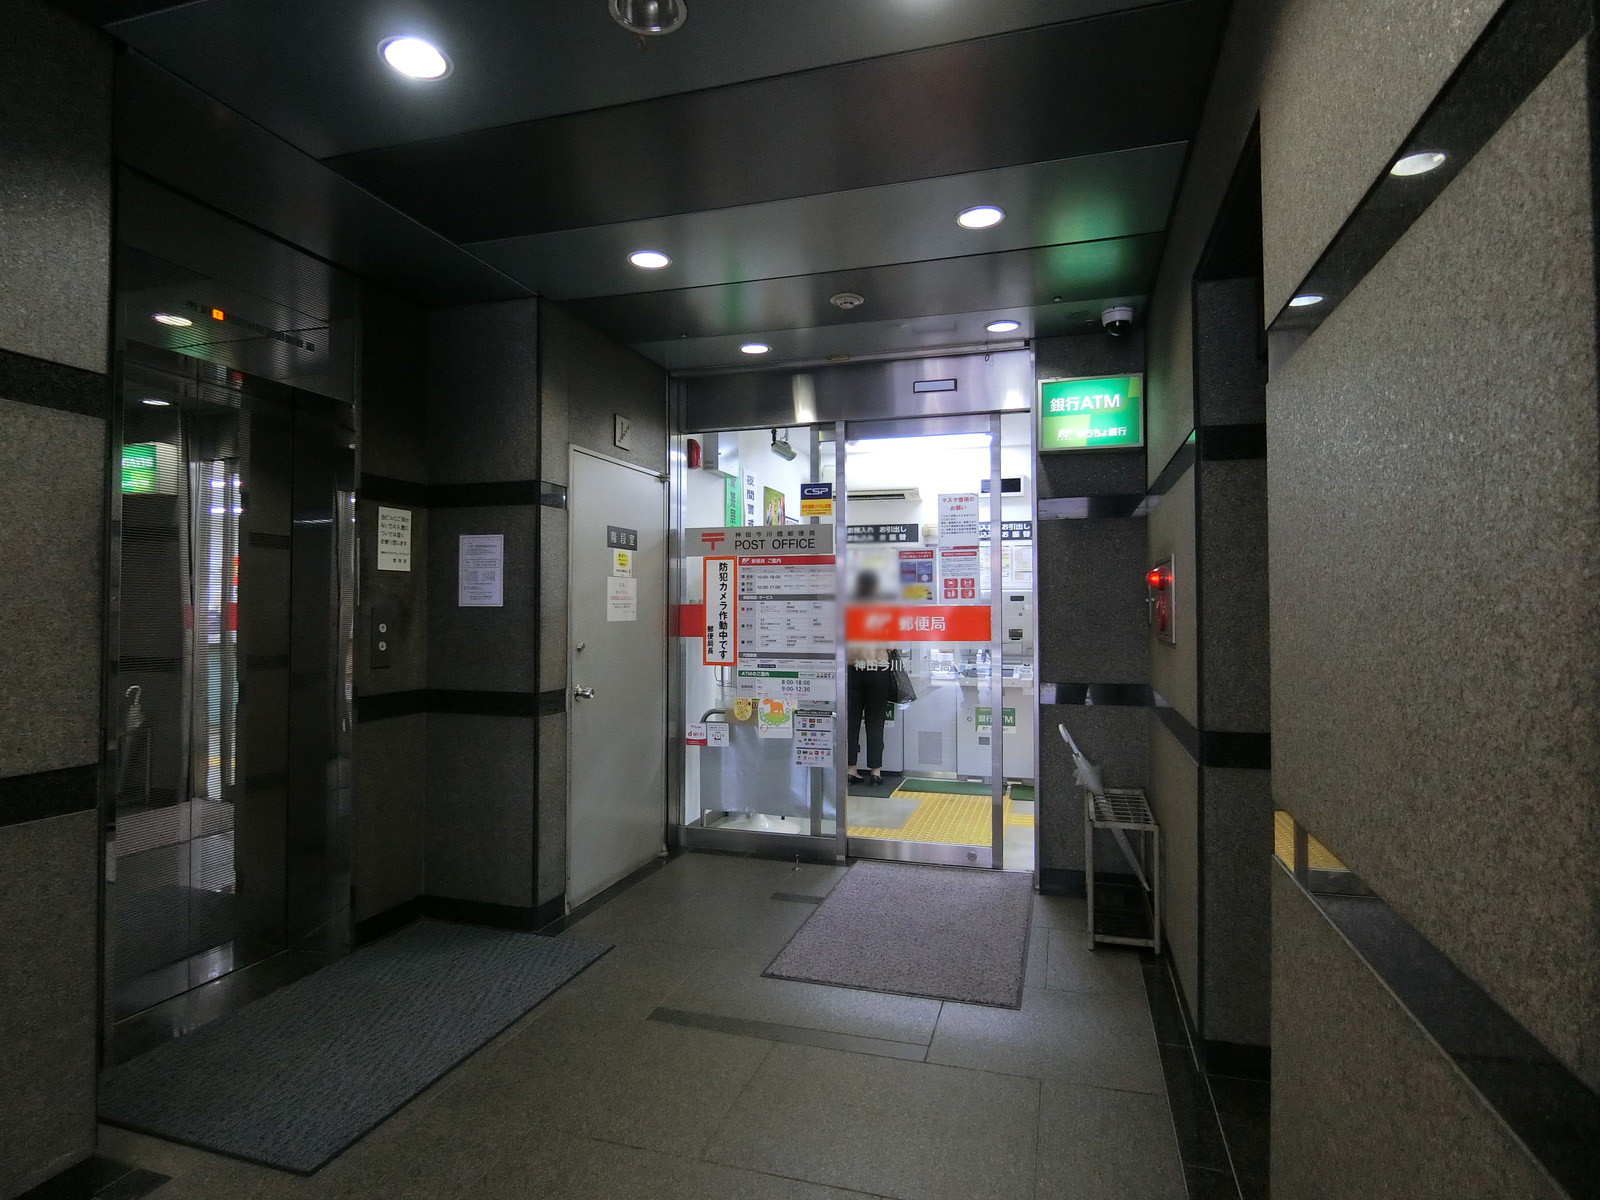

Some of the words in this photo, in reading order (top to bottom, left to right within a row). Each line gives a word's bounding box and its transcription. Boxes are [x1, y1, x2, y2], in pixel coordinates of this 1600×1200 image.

[1050, 394, 1120, 412] 銀行ATM
[735, 530, 815, 538] 神田今川橋郵便局
[1002, 523, 1030, 531] お引出し
[611, 531, 634, 546] 階段室
[735, 540, 766, 551] POST
[772, 538, 815, 550] OFFICE
[719, 563, 728, 660] 防犯カメラ作動中です
[899, 616, 945, 632] 郵便局
